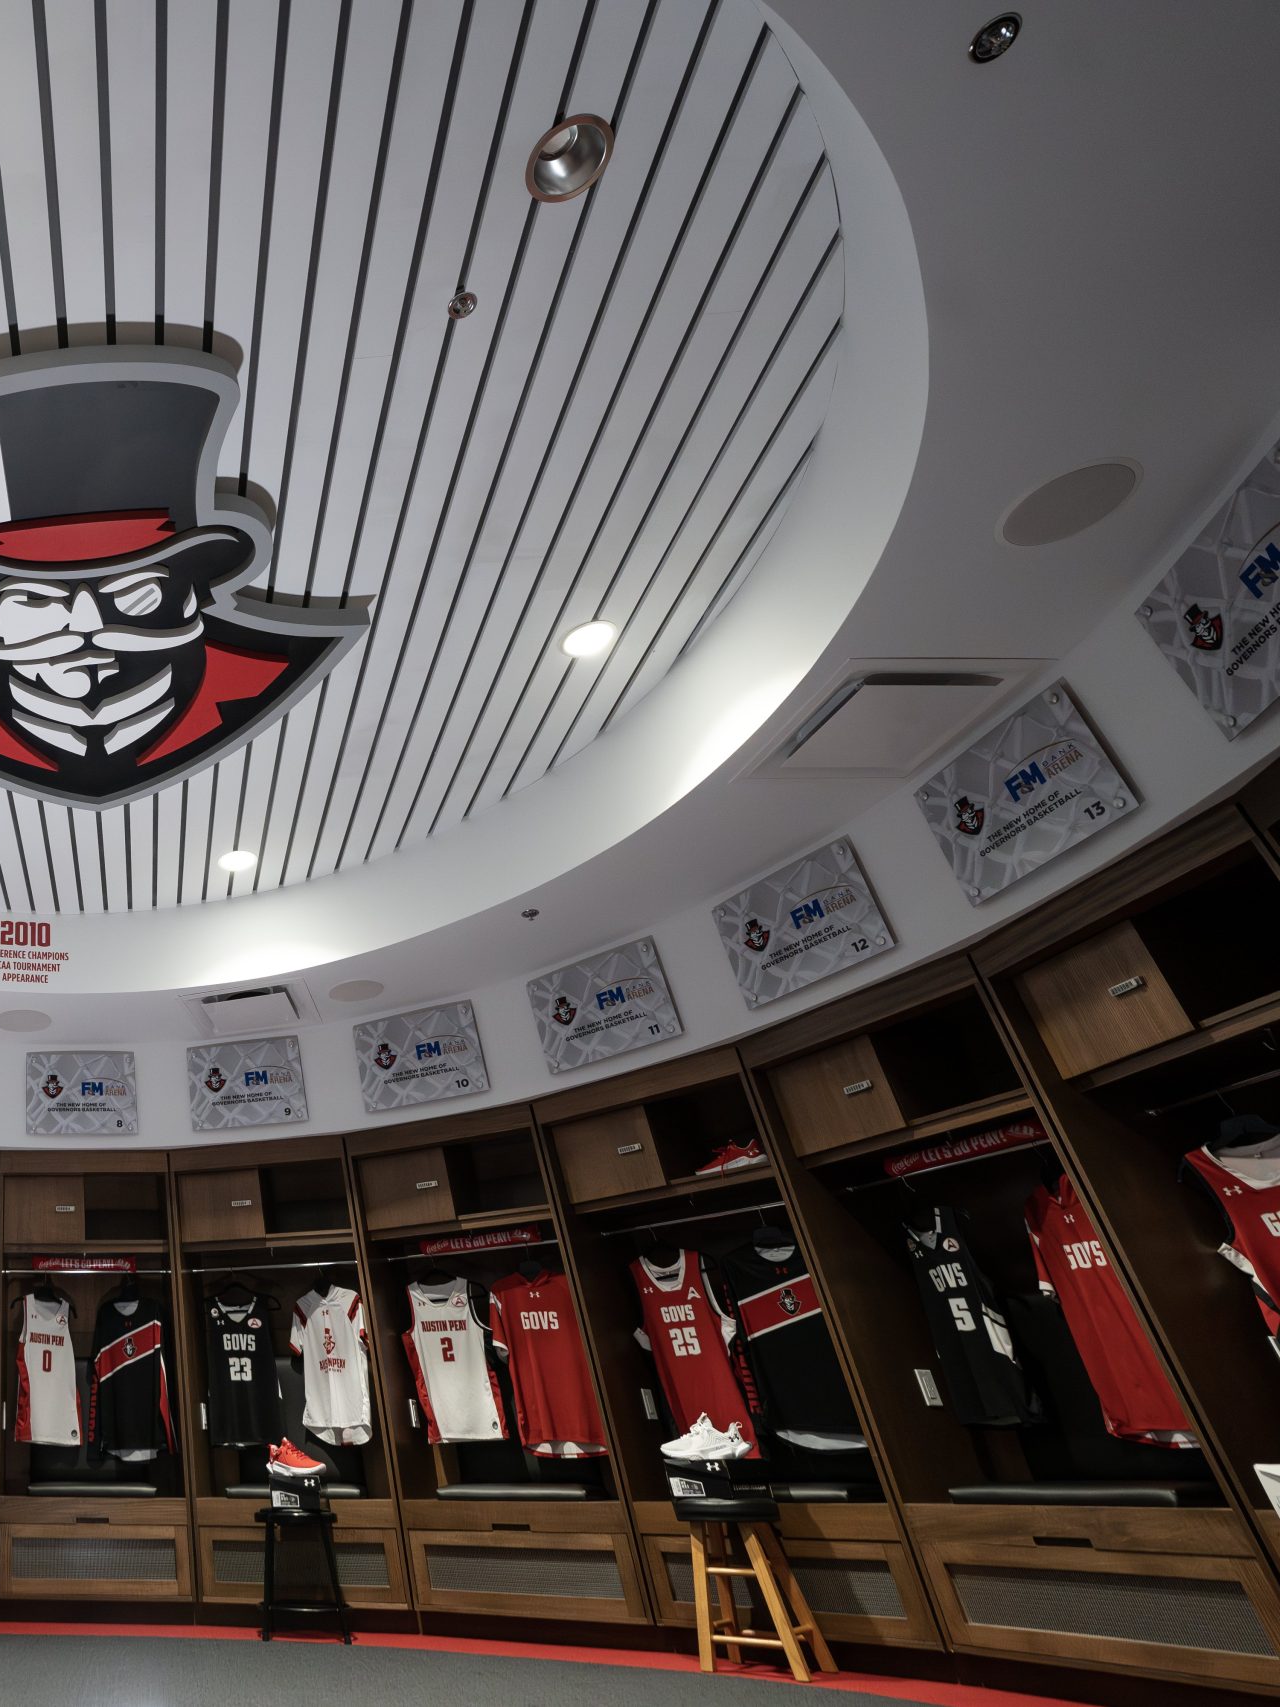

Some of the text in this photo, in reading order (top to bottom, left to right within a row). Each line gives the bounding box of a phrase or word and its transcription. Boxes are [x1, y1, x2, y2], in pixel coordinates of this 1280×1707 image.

[1230, 635, 1251, 656] THE
[1247, 614, 1271, 640] NEW
[1224, 622, 1278, 677] GOVERNORS
[1041, 741, 1074, 768] BANK
[1044, 746, 1084, 779] ARENA
[978, 786, 1082, 858] GOVERNORS BASKETBALL
[986, 789, 1062, 843] THE NEW HOME OF
[1082, 799, 1107, 822] 13
[824, 892, 857, 915] ARENA
[0, 920, 50, 947] 2010
[768, 923, 835, 959] THE NEW HOME OF
[850, 936, 869, 953] 12
[28, 950, 69, 960] CHAMPIONS
[760, 923, 852, 971] GOVERNORS BASKETBALL
[2, 973, 48, 984] APPEARANCE
[13, 962, 60, 972] TOURNAMENT
[625, 984, 655, 1001] ARENA
[564, 1010, 648, 1042] GOVERNORS BASKETBALL
[573, 1009, 634, 1033] THE NEW HOME OF
[647, 1023, 661, 1035] 11
[455, 1077, 469, 1088] 10
[283, 1107, 291, 1115] 9
[116, 1119, 122, 1127] 8
[520, 1311, 559, 1330] GOVS
[660, 1304, 696, 1324] GOVS
[948, 1297, 976, 1331] 5
[421, 1320, 448, 1332] AUSTIN
[29, 1332, 50, 1346] AUSTIN
[223, 1333, 256, 1351] GOVS
[440, 1337, 455, 1362] 2
[670, 1327, 702, 1357] 25
[42, 1350, 52, 1373] 0
[229, 1357, 252, 1381] 23
